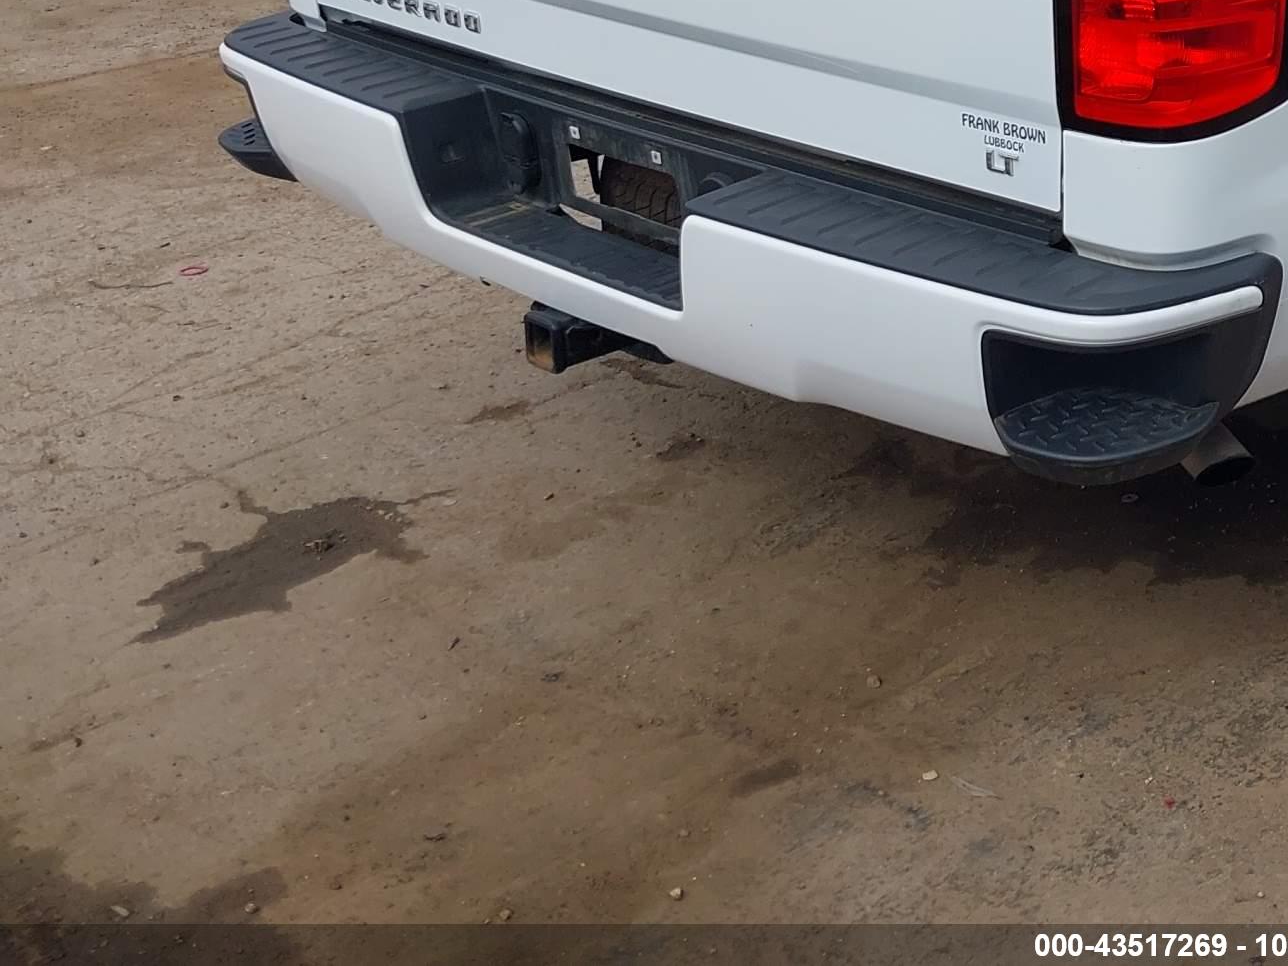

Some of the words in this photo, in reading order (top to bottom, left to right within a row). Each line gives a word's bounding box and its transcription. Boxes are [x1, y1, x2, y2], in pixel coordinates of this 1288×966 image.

[961, 113, 1000, 135] FRANK
[1003, 121, 1046, 145] BROWN
[984, 135, 1025, 153] LUBBOCK
[985, 149, 1020, 177] LT
